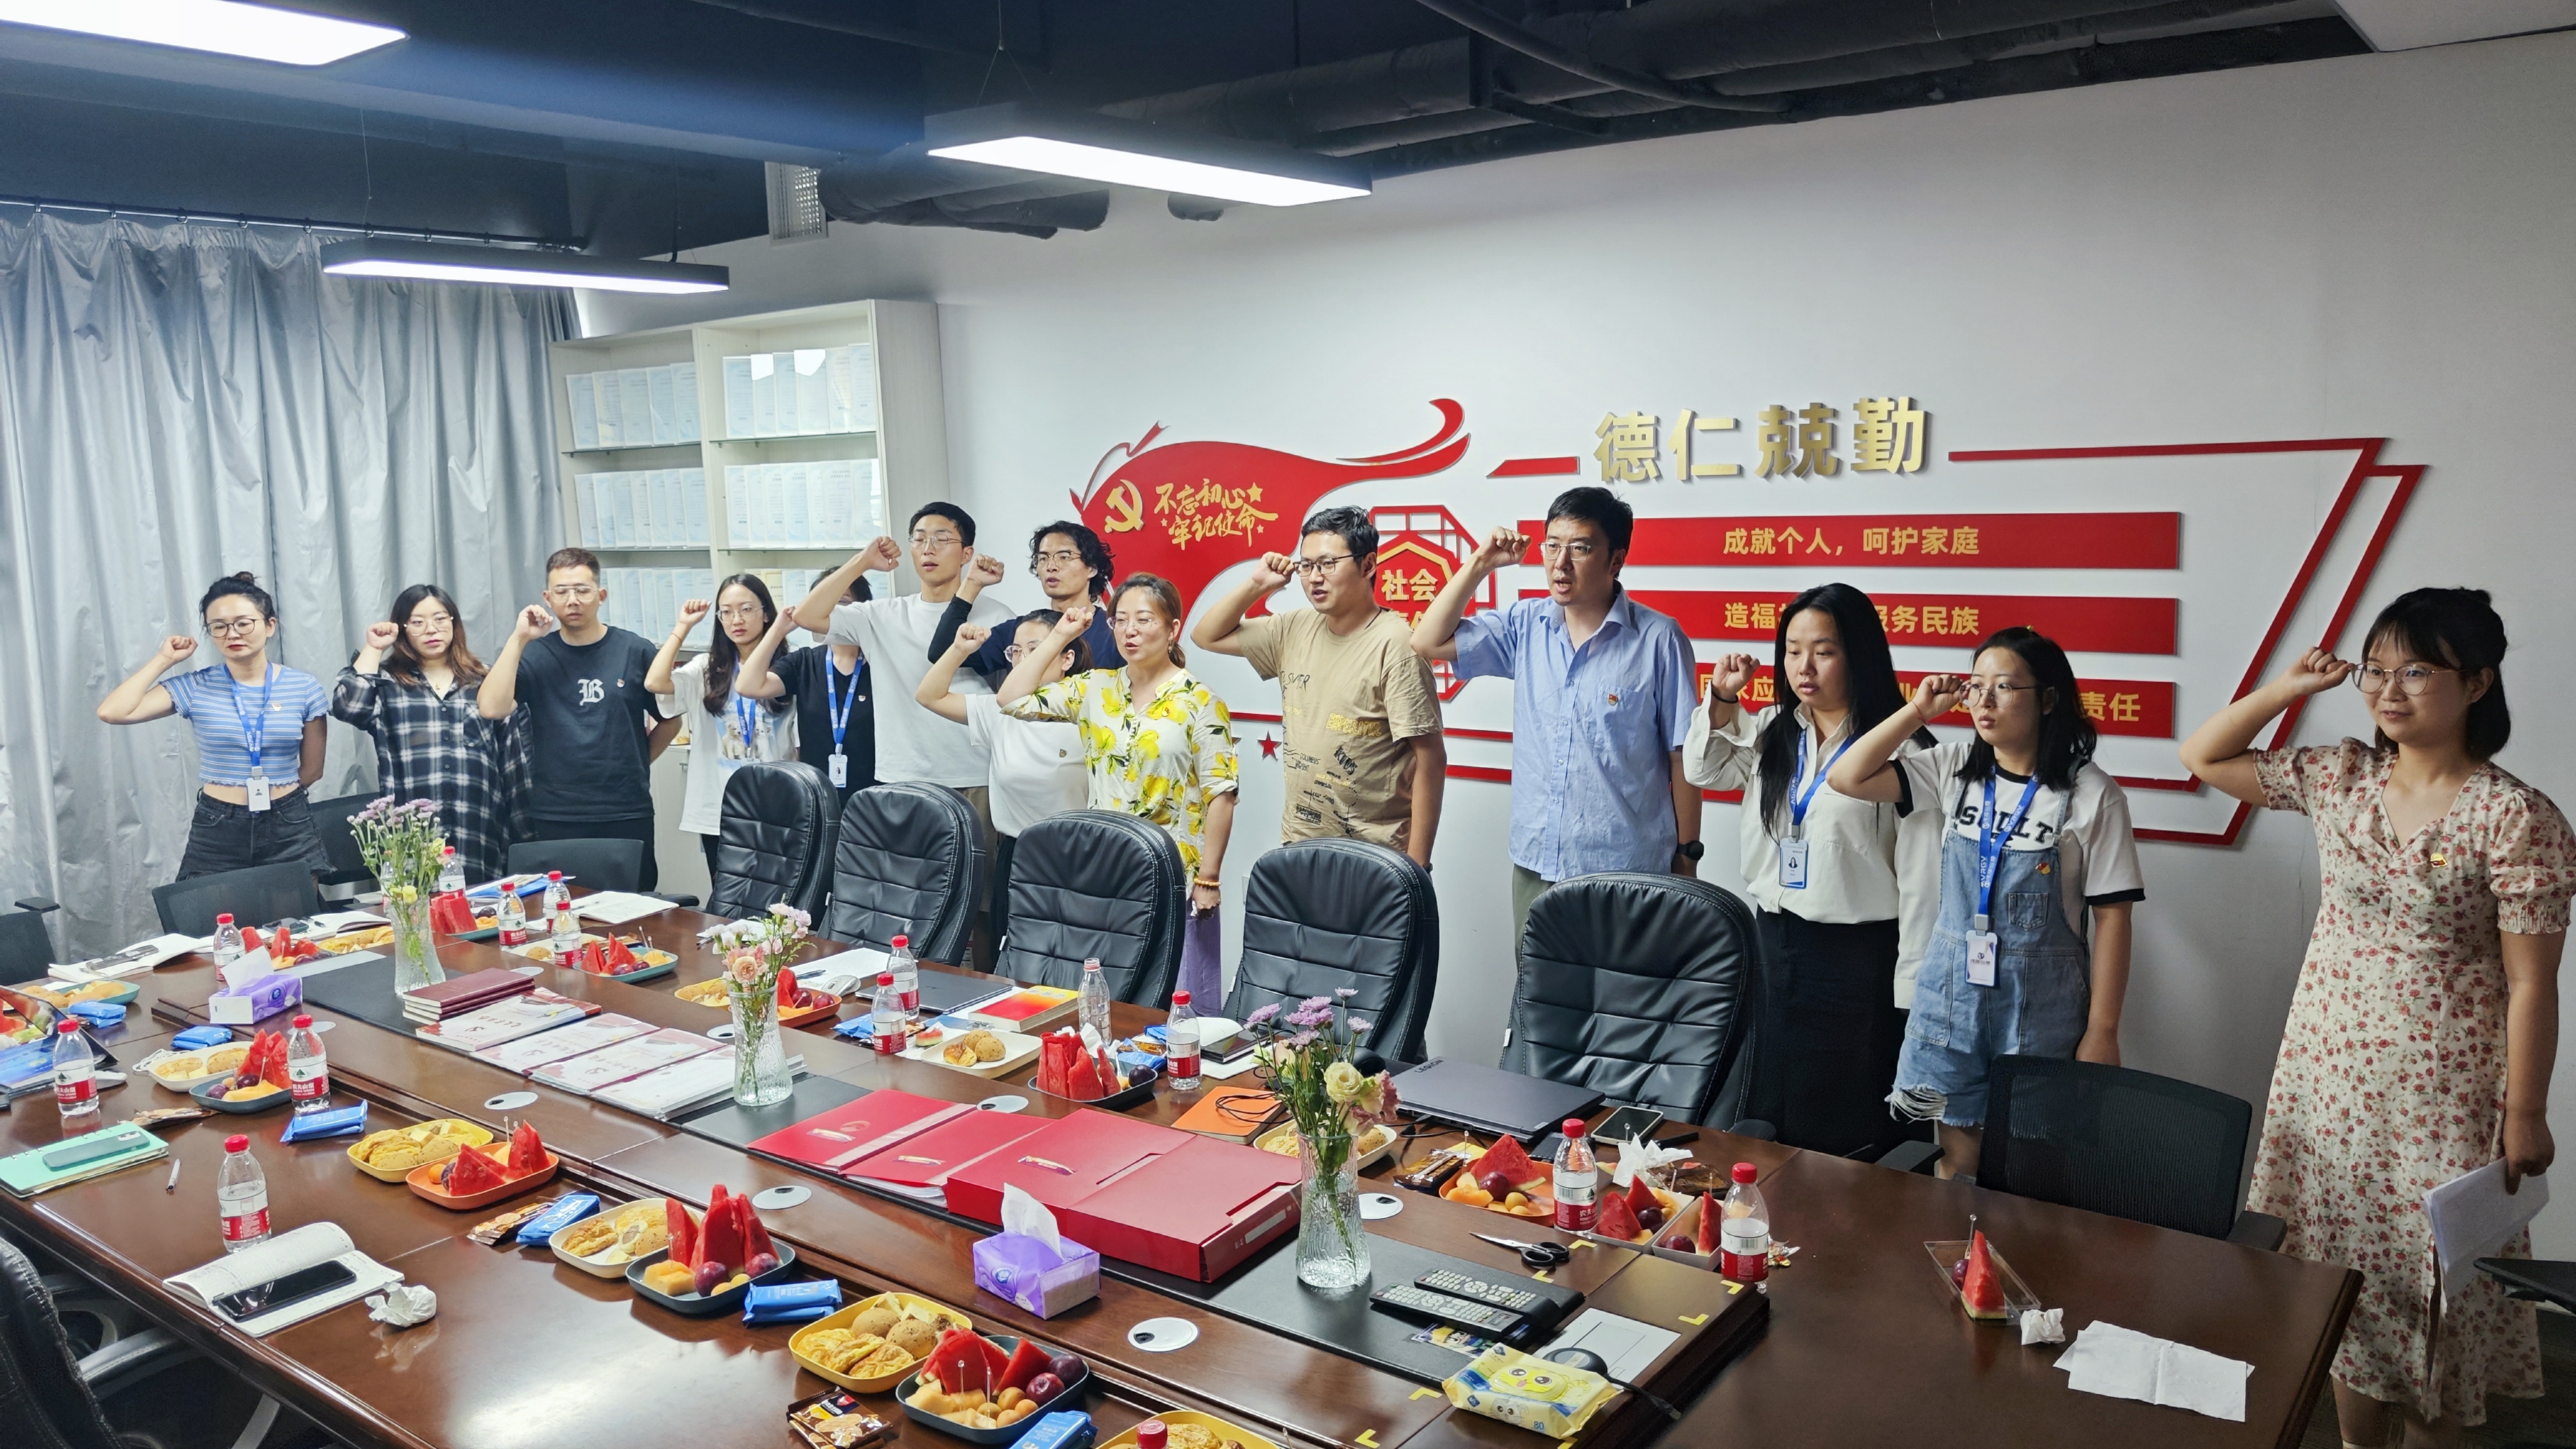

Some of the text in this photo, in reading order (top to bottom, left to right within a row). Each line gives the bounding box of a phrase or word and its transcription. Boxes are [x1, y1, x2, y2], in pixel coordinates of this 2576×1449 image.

[1595, 396, 1928, 482] 德仁兢勤
[1153, 478, 1246, 516] 不忘初心
[1168, 502, 1279, 551] 牢记使命
[1723, 526, 1980, 556] 成就个人，呵护家庭
[1381, 568, 1438, 602] 社会
[1959, 806, 2053, 845] SULT
[1533, 1421, 1545, 1430] 80
